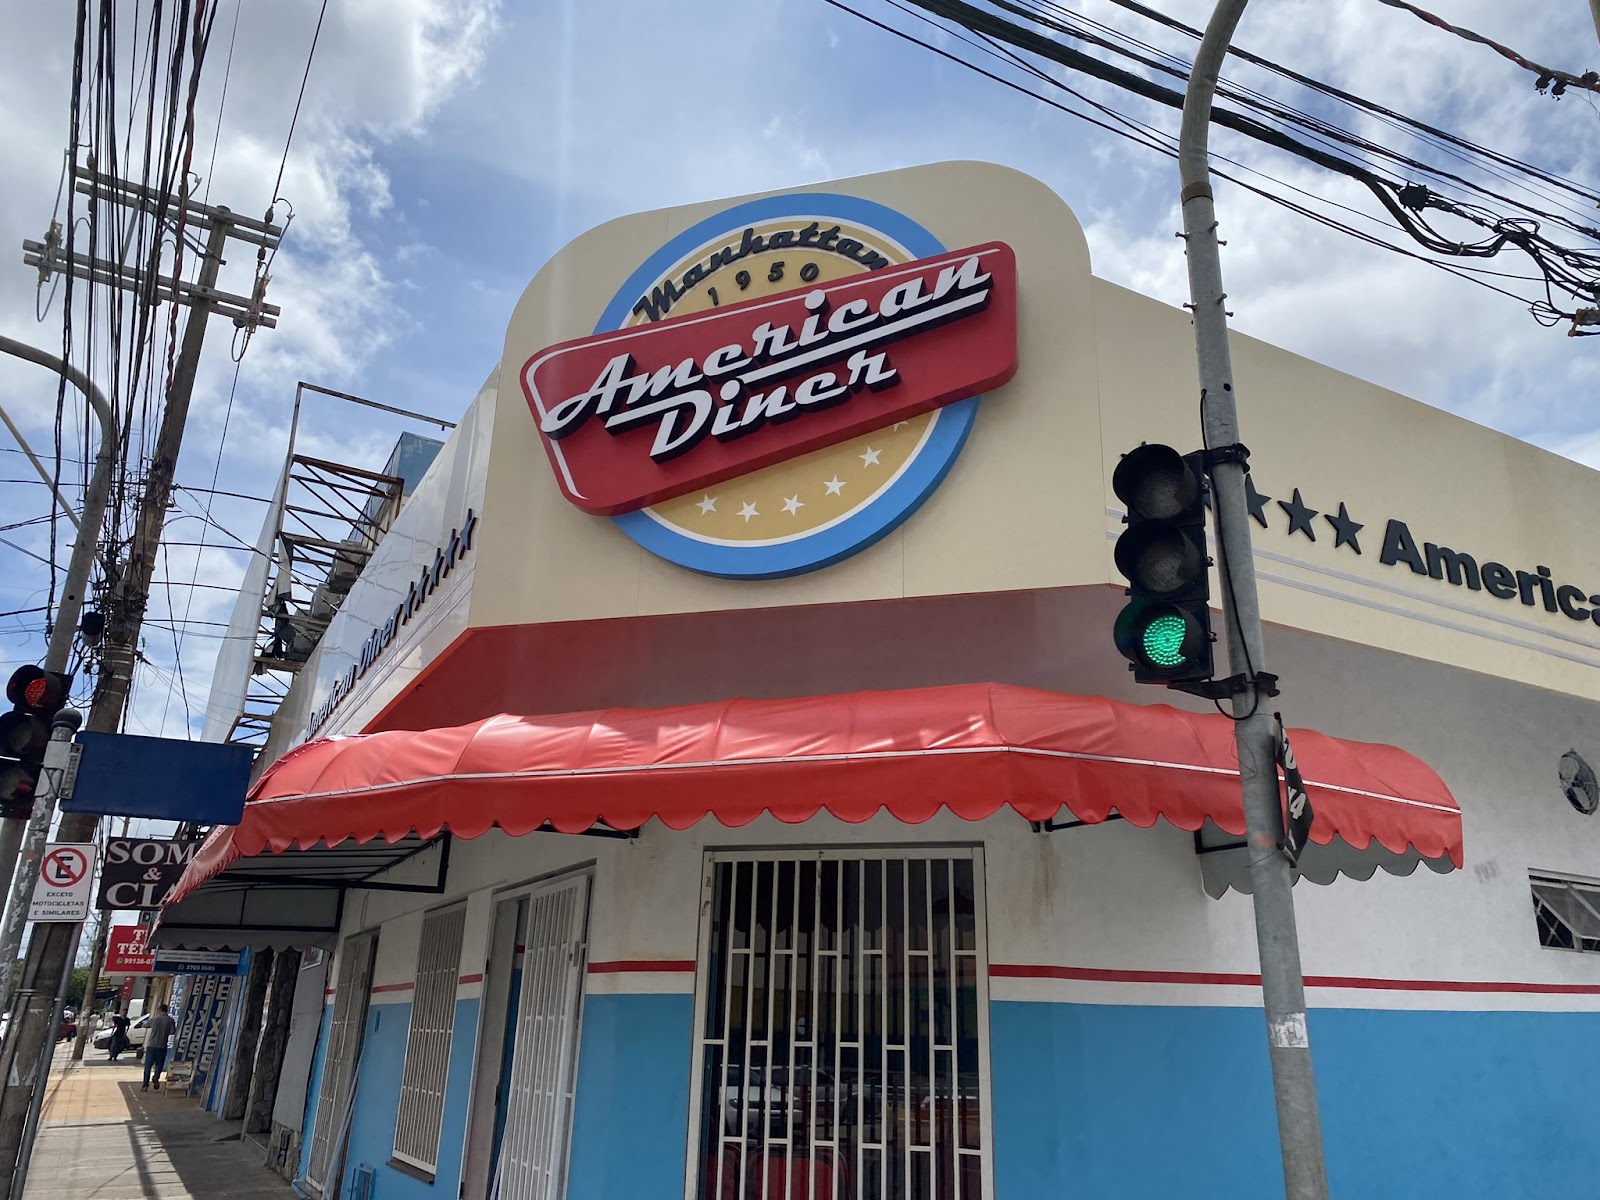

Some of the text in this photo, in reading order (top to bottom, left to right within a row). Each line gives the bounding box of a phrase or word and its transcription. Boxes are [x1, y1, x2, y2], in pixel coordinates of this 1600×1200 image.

[632, 221, 889, 323] Manhattan
[707, 262, 820, 306] 1950
[541, 256, 993, 438] American
[650, 349, 898, 462] Diner
[357, 603, 404, 680] Diner
[106, 840, 197, 865] SOM
[142, 867, 162, 881] &
[187, 975, 215, 1058] EIXES
